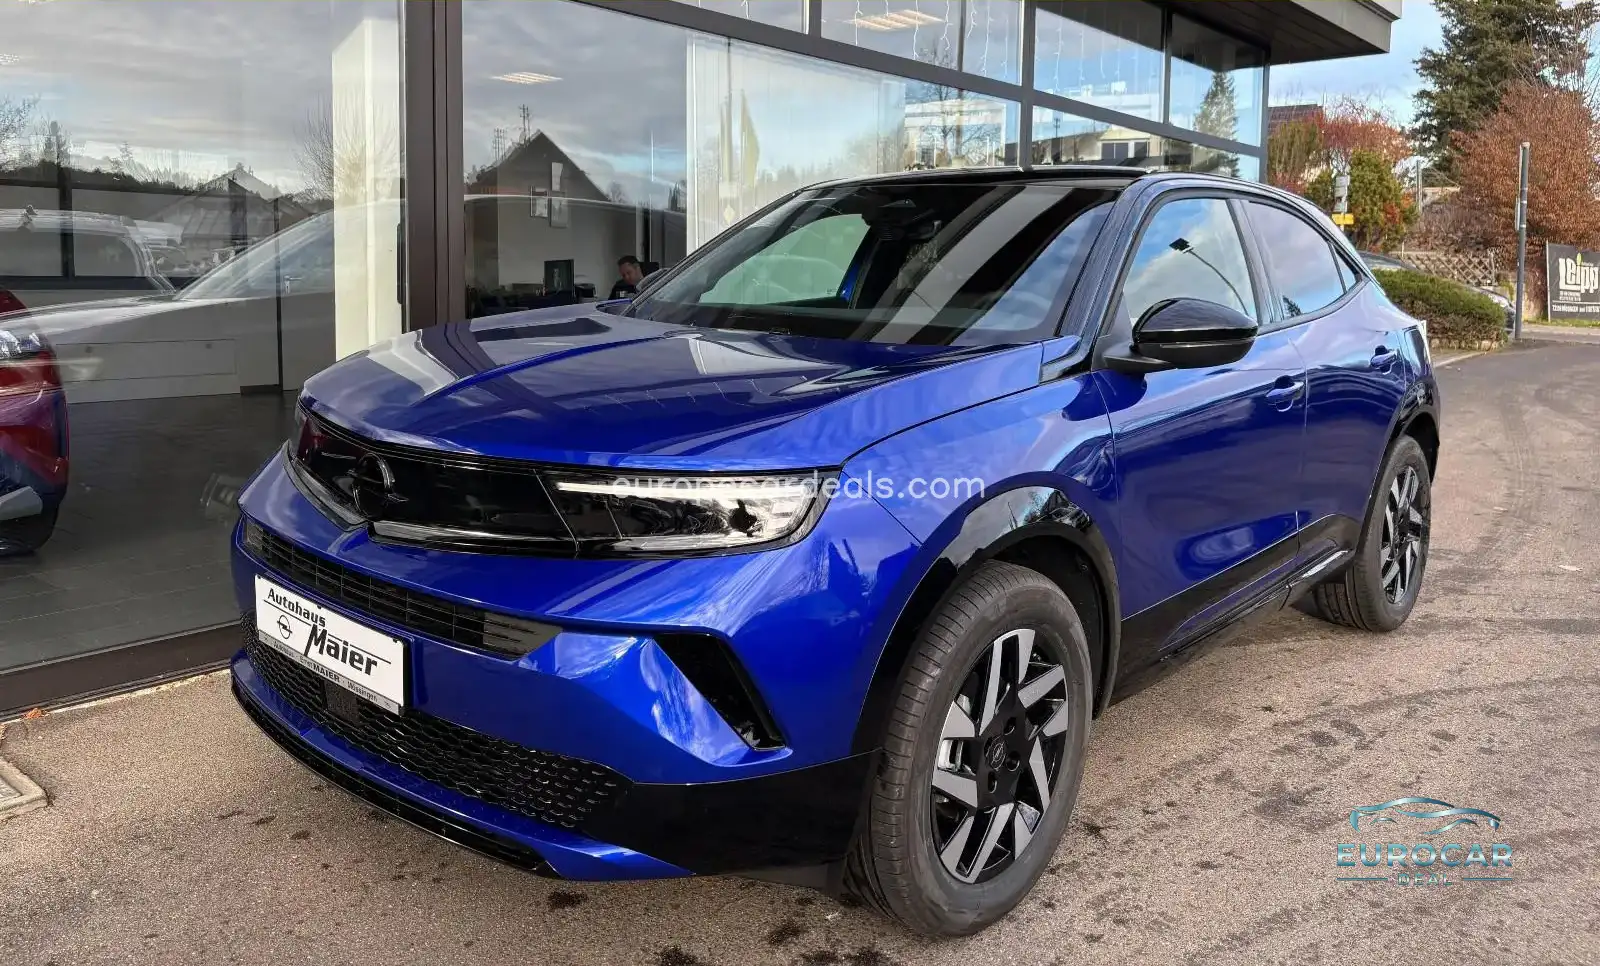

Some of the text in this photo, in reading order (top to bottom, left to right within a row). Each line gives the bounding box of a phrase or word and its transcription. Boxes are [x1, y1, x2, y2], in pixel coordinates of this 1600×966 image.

[267, 587, 327, 628] Autohaus
[303, 623, 378, 676] Maier
[312, 662, 340, 683] MAIER
